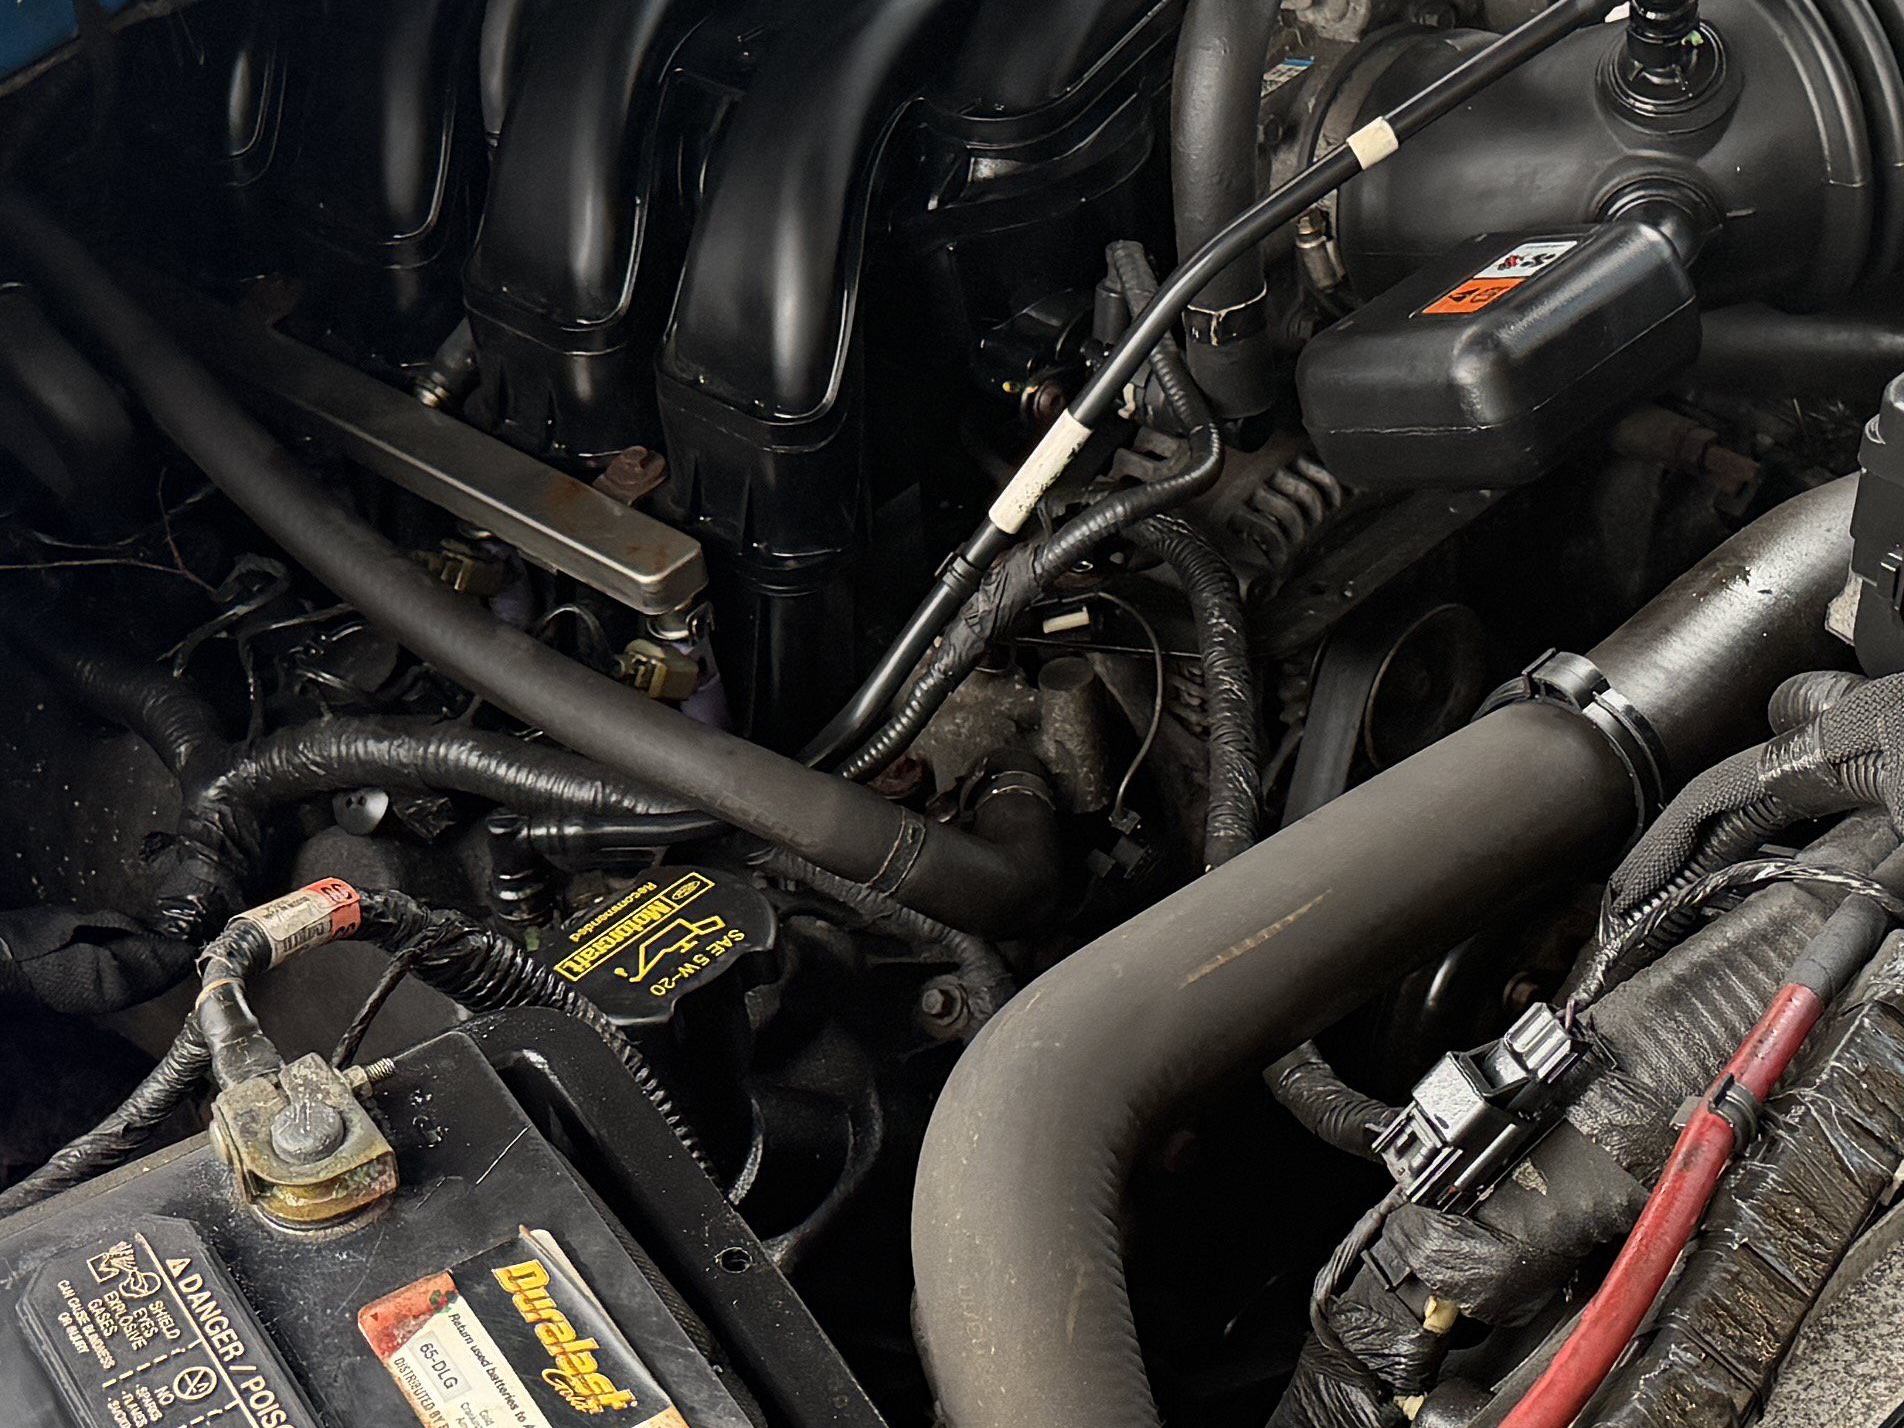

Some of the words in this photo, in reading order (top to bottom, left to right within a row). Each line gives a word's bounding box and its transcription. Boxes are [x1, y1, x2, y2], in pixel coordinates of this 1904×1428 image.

[562, 897, 672, 973] Motorcraft
[568, 881, 658, 943] Recommended
[706, 928, 746, 958] SAE
[649, 952, 712, 997] 5W-20
[85, 1295, 120, 1338] GASES
[101, 1288, 148, 1352] EXPLOSIVE
[130, 1305, 160, 1340] EYES
[146, 1297, 183, 1343] SHIELD
[176, 1270, 247, 1364] DANGER
[491, 1257, 637, 1408] Duralast
[392, 1355, 436, 1413] DISTRIBUTED
[428, 1408, 444, 1425] BY
[417, 1338, 460, 1392] 65-DLG
[447, 1310, 475, 1346] Return
[469, 1341, 492, 1369] used
[484, 1364, 521, 1411] batteries
[513, 1408, 529, 1424] to
[543, 1368, 605, 1412] Gold
[152, 1383, 175, 1408] NO
